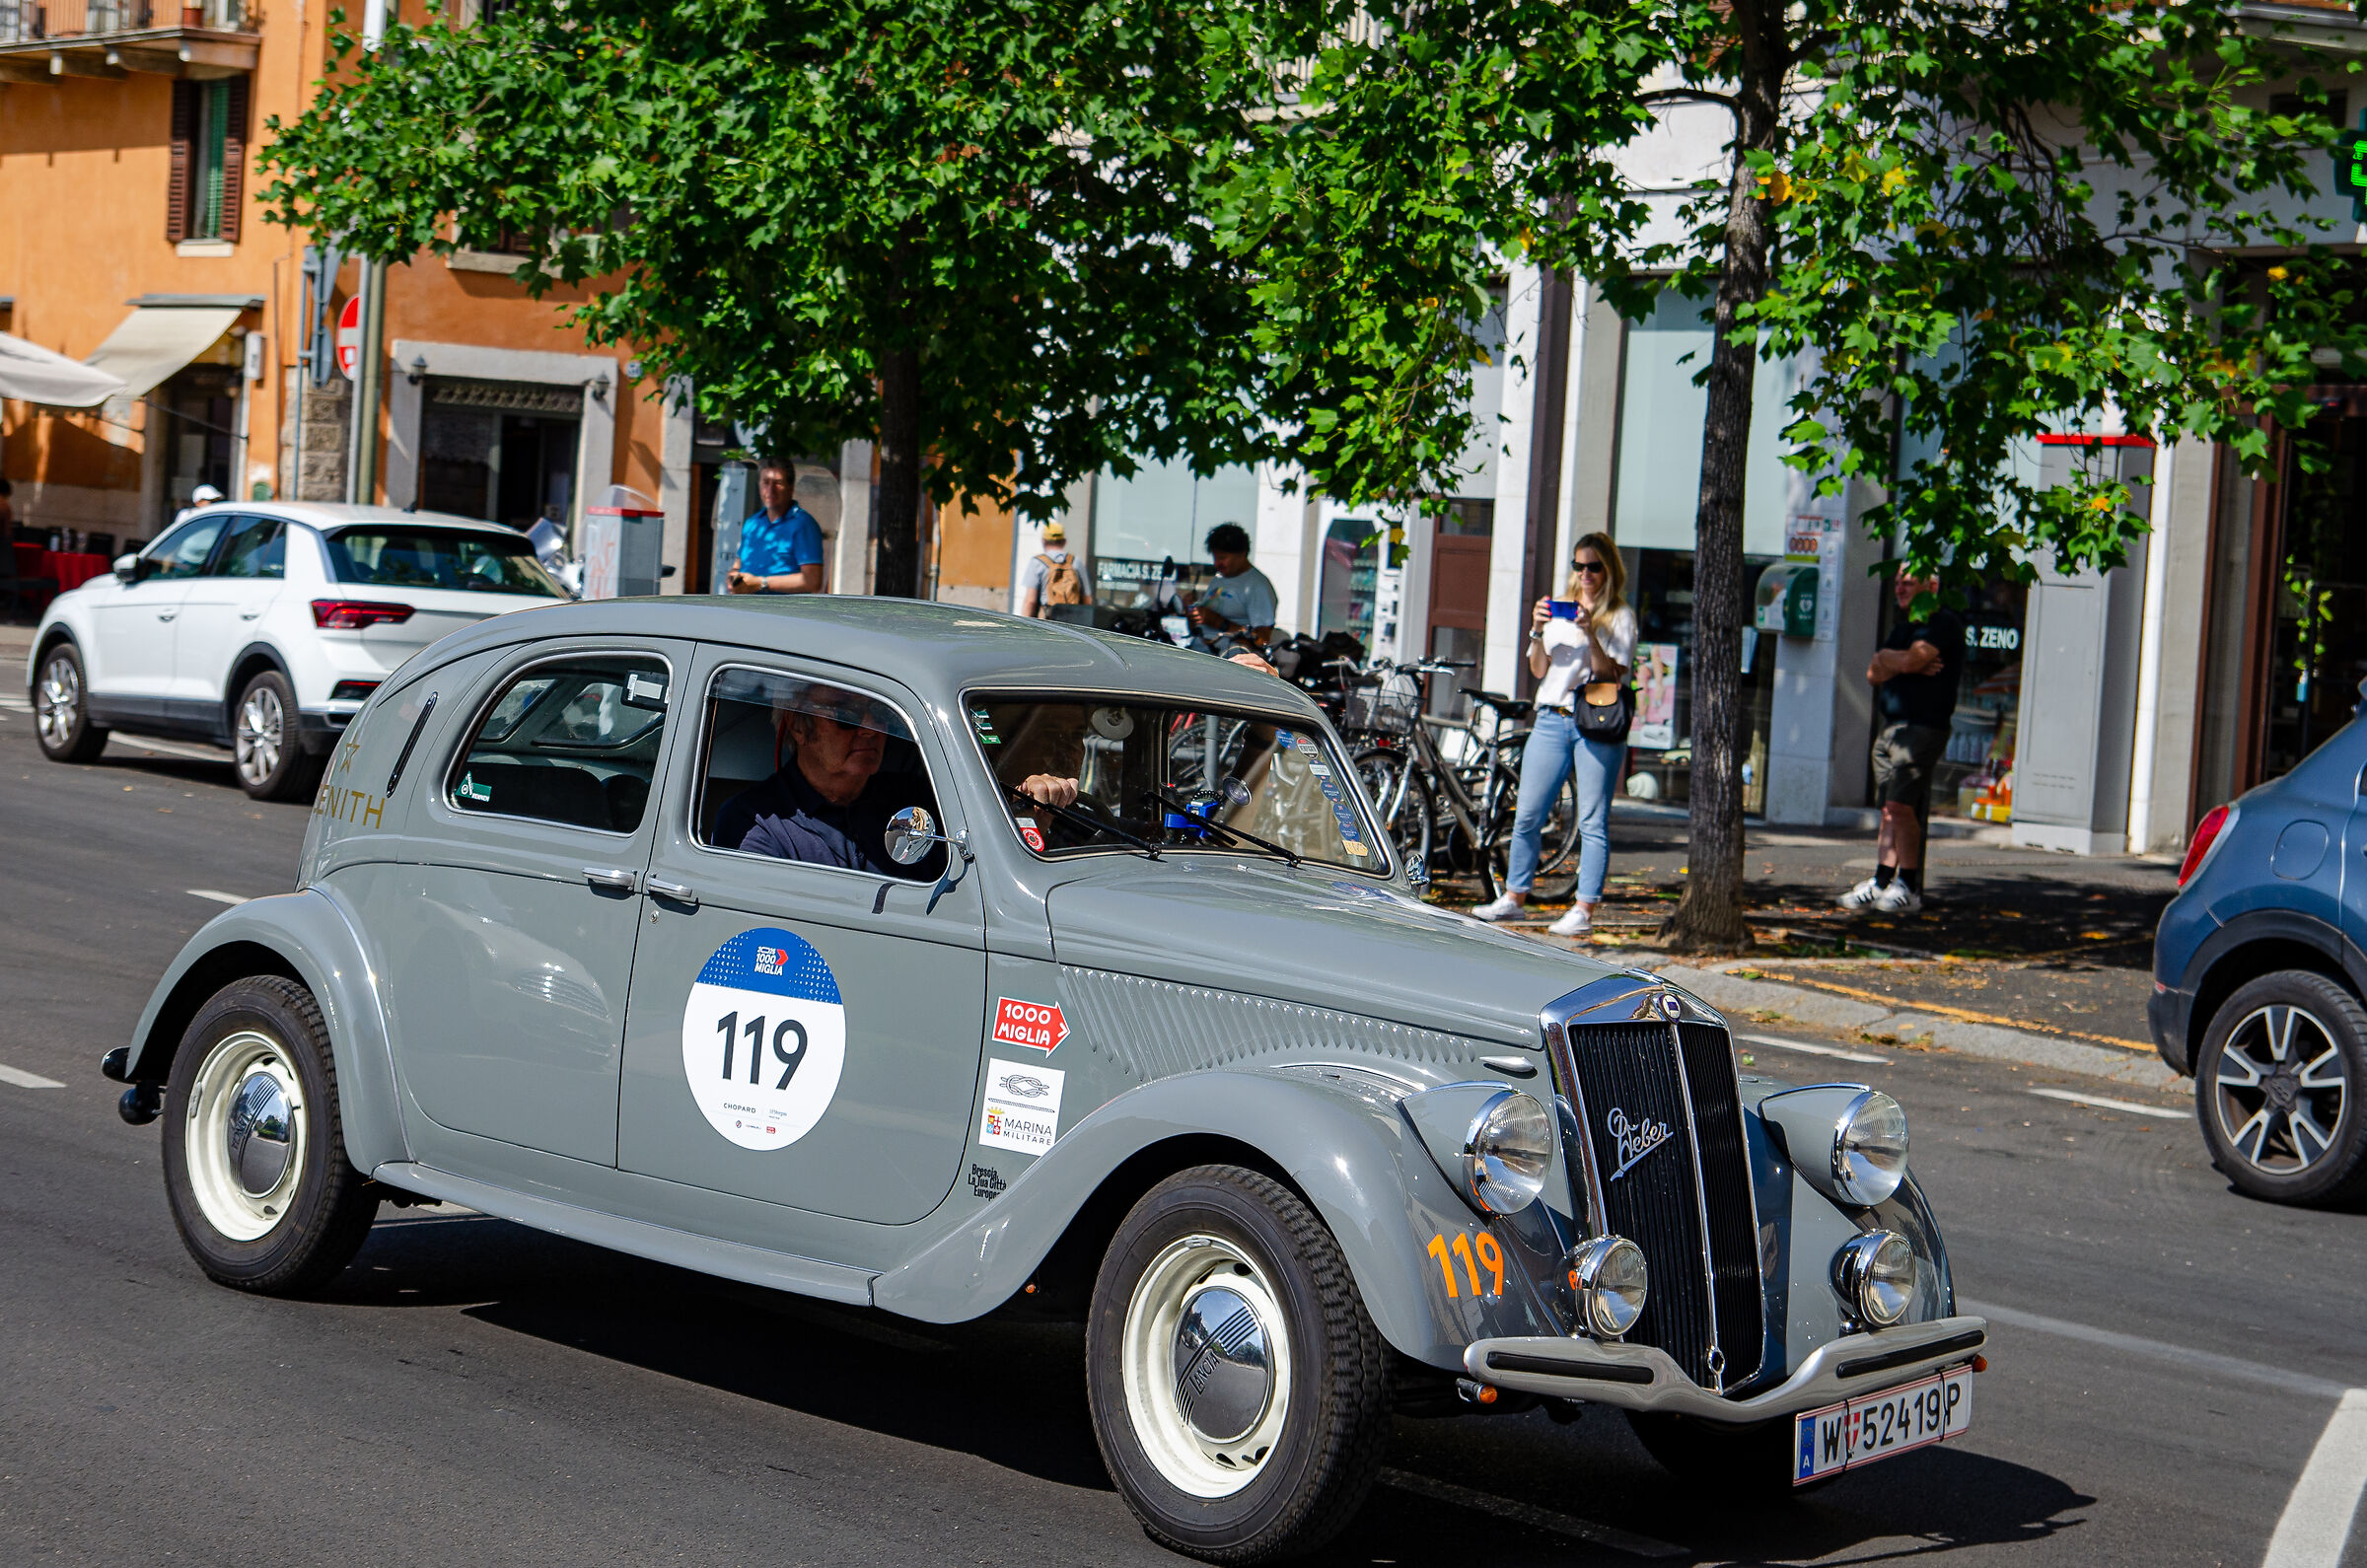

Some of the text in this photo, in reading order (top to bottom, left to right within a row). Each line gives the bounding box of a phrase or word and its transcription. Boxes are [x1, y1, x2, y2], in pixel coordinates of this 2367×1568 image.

[1965, 624, 2019, 650] S. ZENO
[314, 784, 386, 829] ENITH
[753, 962, 783, 976] MIGLIA
[755, 953, 776, 964] 1000
[1004, 1003, 1051, 1025] 1000
[997, 1022, 1051, 1046] MIGLIA
[717, 1011, 808, 1091] 119
[723, 1103, 756, 1113] CHOPARD
[1003, 1130, 1052, 1146] MILITARE
[1004, 1117, 1052, 1137] MARINA
[1608, 1106, 1674, 1181] Weber
[968, 1174, 976, 1186] La
[976, 1175, 989, 1188] Tua
[1427, 1232, 1504, 1298] 119
[1189, 1352, 1221, 1395] LANCIA
[1823, 1416, 1841, 1463] W
[1802, 1455, 1811, 1469] A
